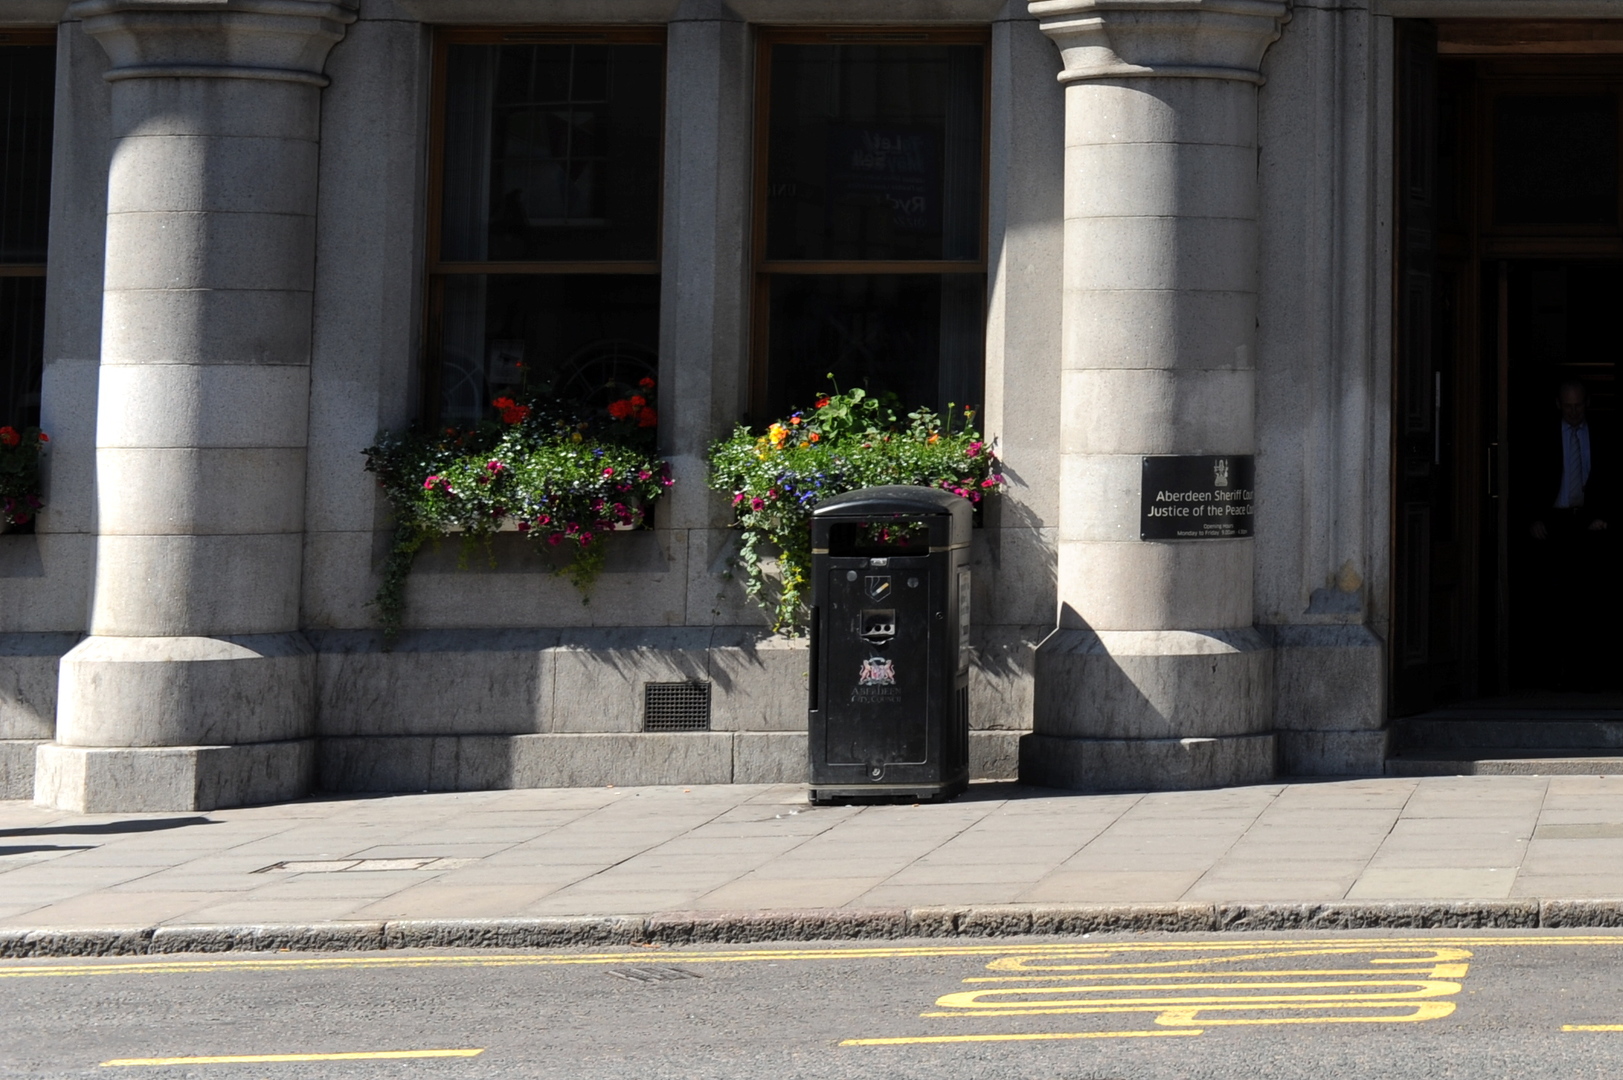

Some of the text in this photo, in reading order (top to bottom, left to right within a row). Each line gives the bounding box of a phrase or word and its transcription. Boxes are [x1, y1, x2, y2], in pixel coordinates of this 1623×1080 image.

[1156, 490, 1211, 501] Aberdeen
[1215, 489, 1241, 500] Sheriff
[1147, 505, 1189, 517] Justice
[1193, 505, 1205, 516] of
[1207, 505, 1223, 516] the
[1225, 505, 1245, 516] Peace
[1177, 529, 1198, 537] Monday
[917, 947, 1472, 1027] STOP
